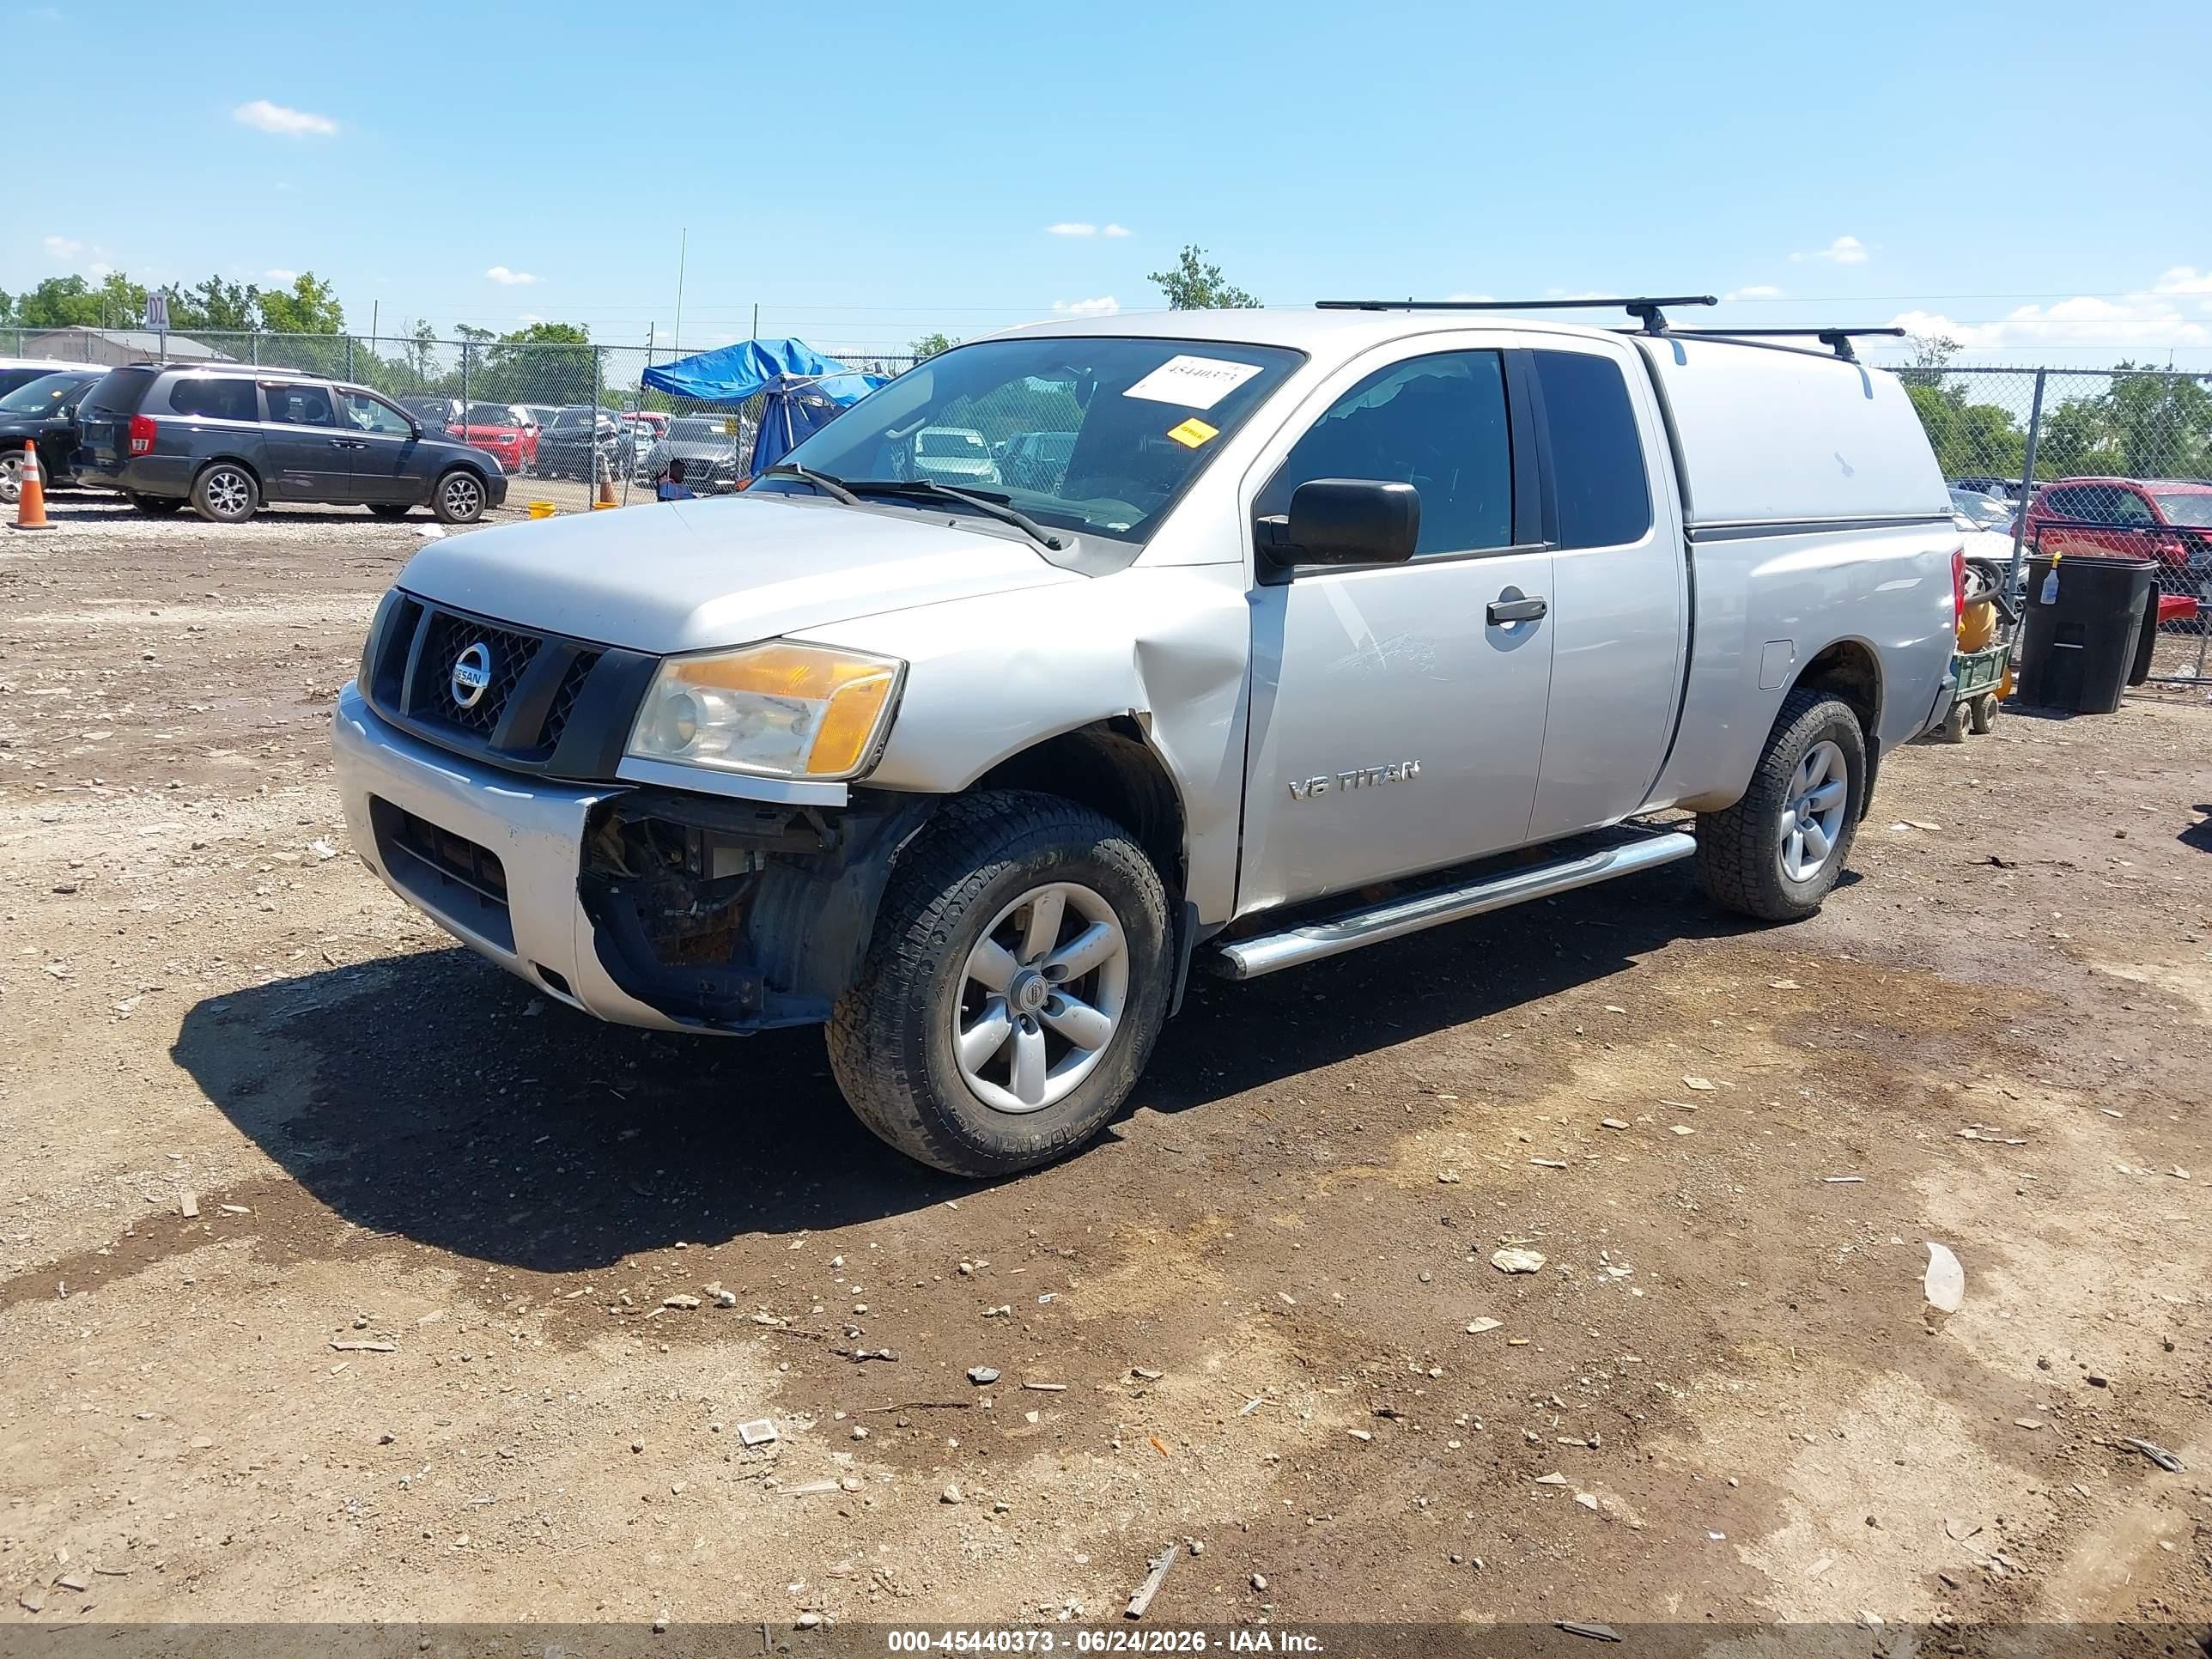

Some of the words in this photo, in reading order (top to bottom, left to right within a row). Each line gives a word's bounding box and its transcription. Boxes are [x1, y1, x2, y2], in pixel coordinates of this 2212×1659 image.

[149, 296, 167, 325] DZ
[1289, 775, 1330, 800] V8
[1336, 759, 1421, 792] TITAN
